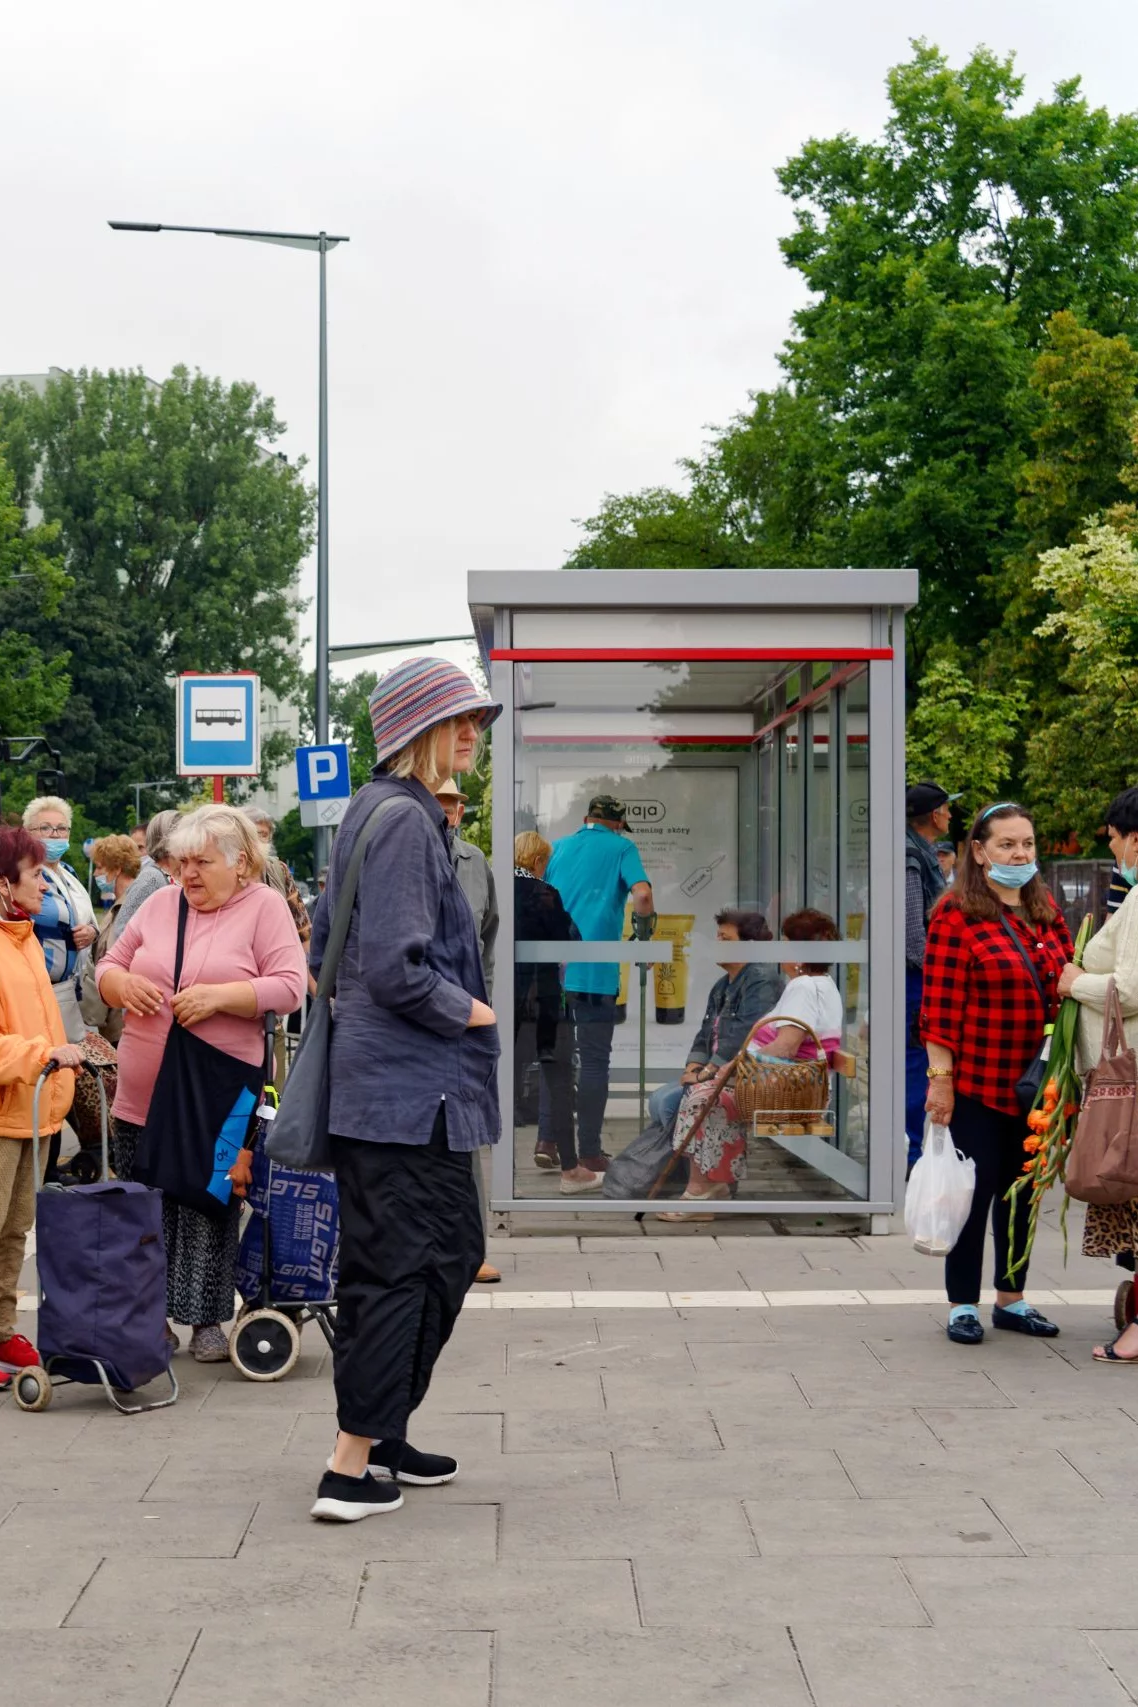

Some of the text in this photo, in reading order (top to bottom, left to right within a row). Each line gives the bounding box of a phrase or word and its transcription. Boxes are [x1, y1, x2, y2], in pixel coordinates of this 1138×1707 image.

[308, 751, 338, 794] P
[628, 806, 657, 820] iaja
[310, 1201, 333, 1282] SLGM
